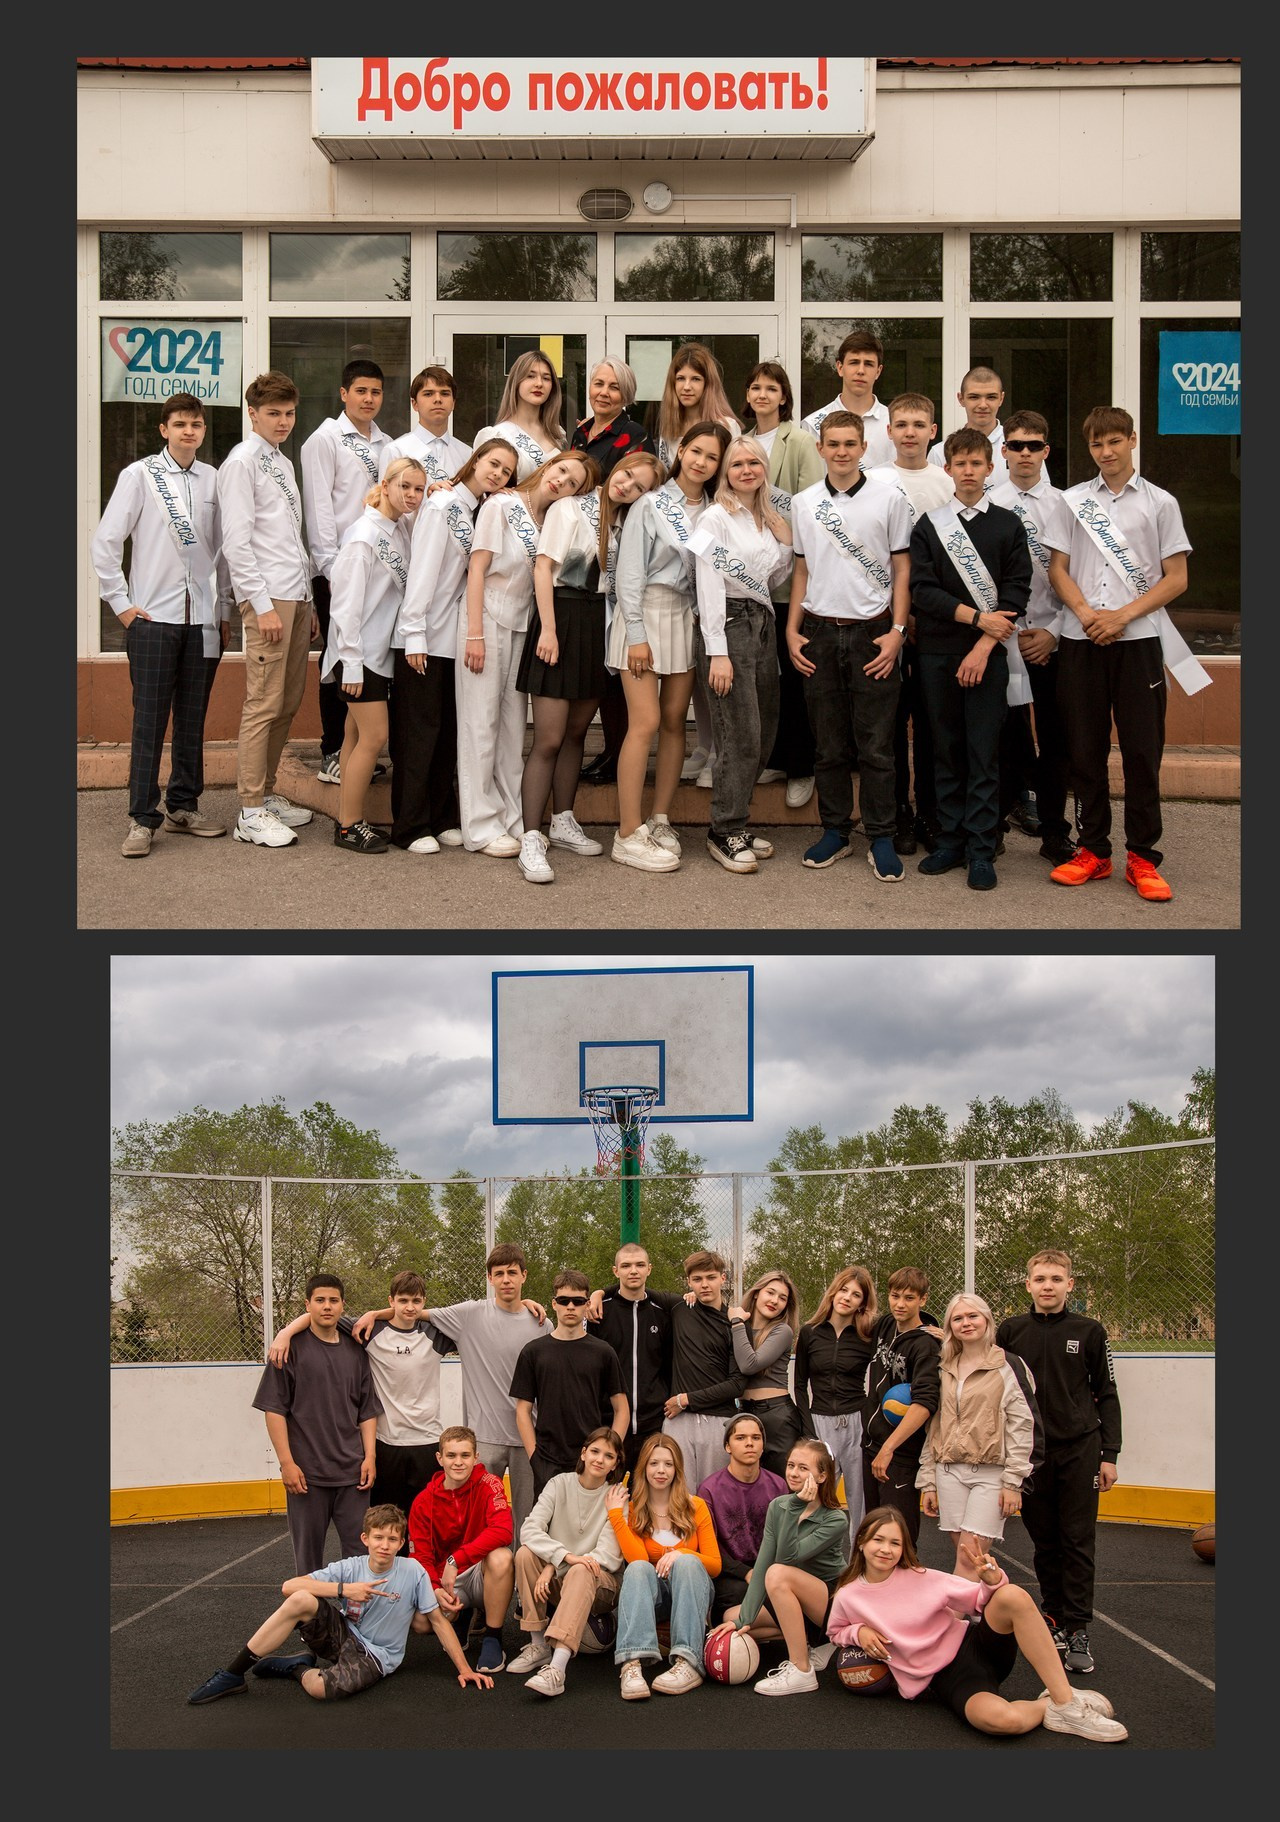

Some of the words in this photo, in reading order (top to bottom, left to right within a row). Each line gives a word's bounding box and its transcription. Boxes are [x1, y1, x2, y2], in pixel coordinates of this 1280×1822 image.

[357, 57, 512, 130] Добро
[528, 57, 830, 112] пожаловать!
[126, 327, 224, 376] 2024
[1181, 363, 1241, 392] 2024
[870, 565, 892, 589] 2024
[1131, 573, 1151, 595] 202
[841, 1668, 875, 1685] PEAK
